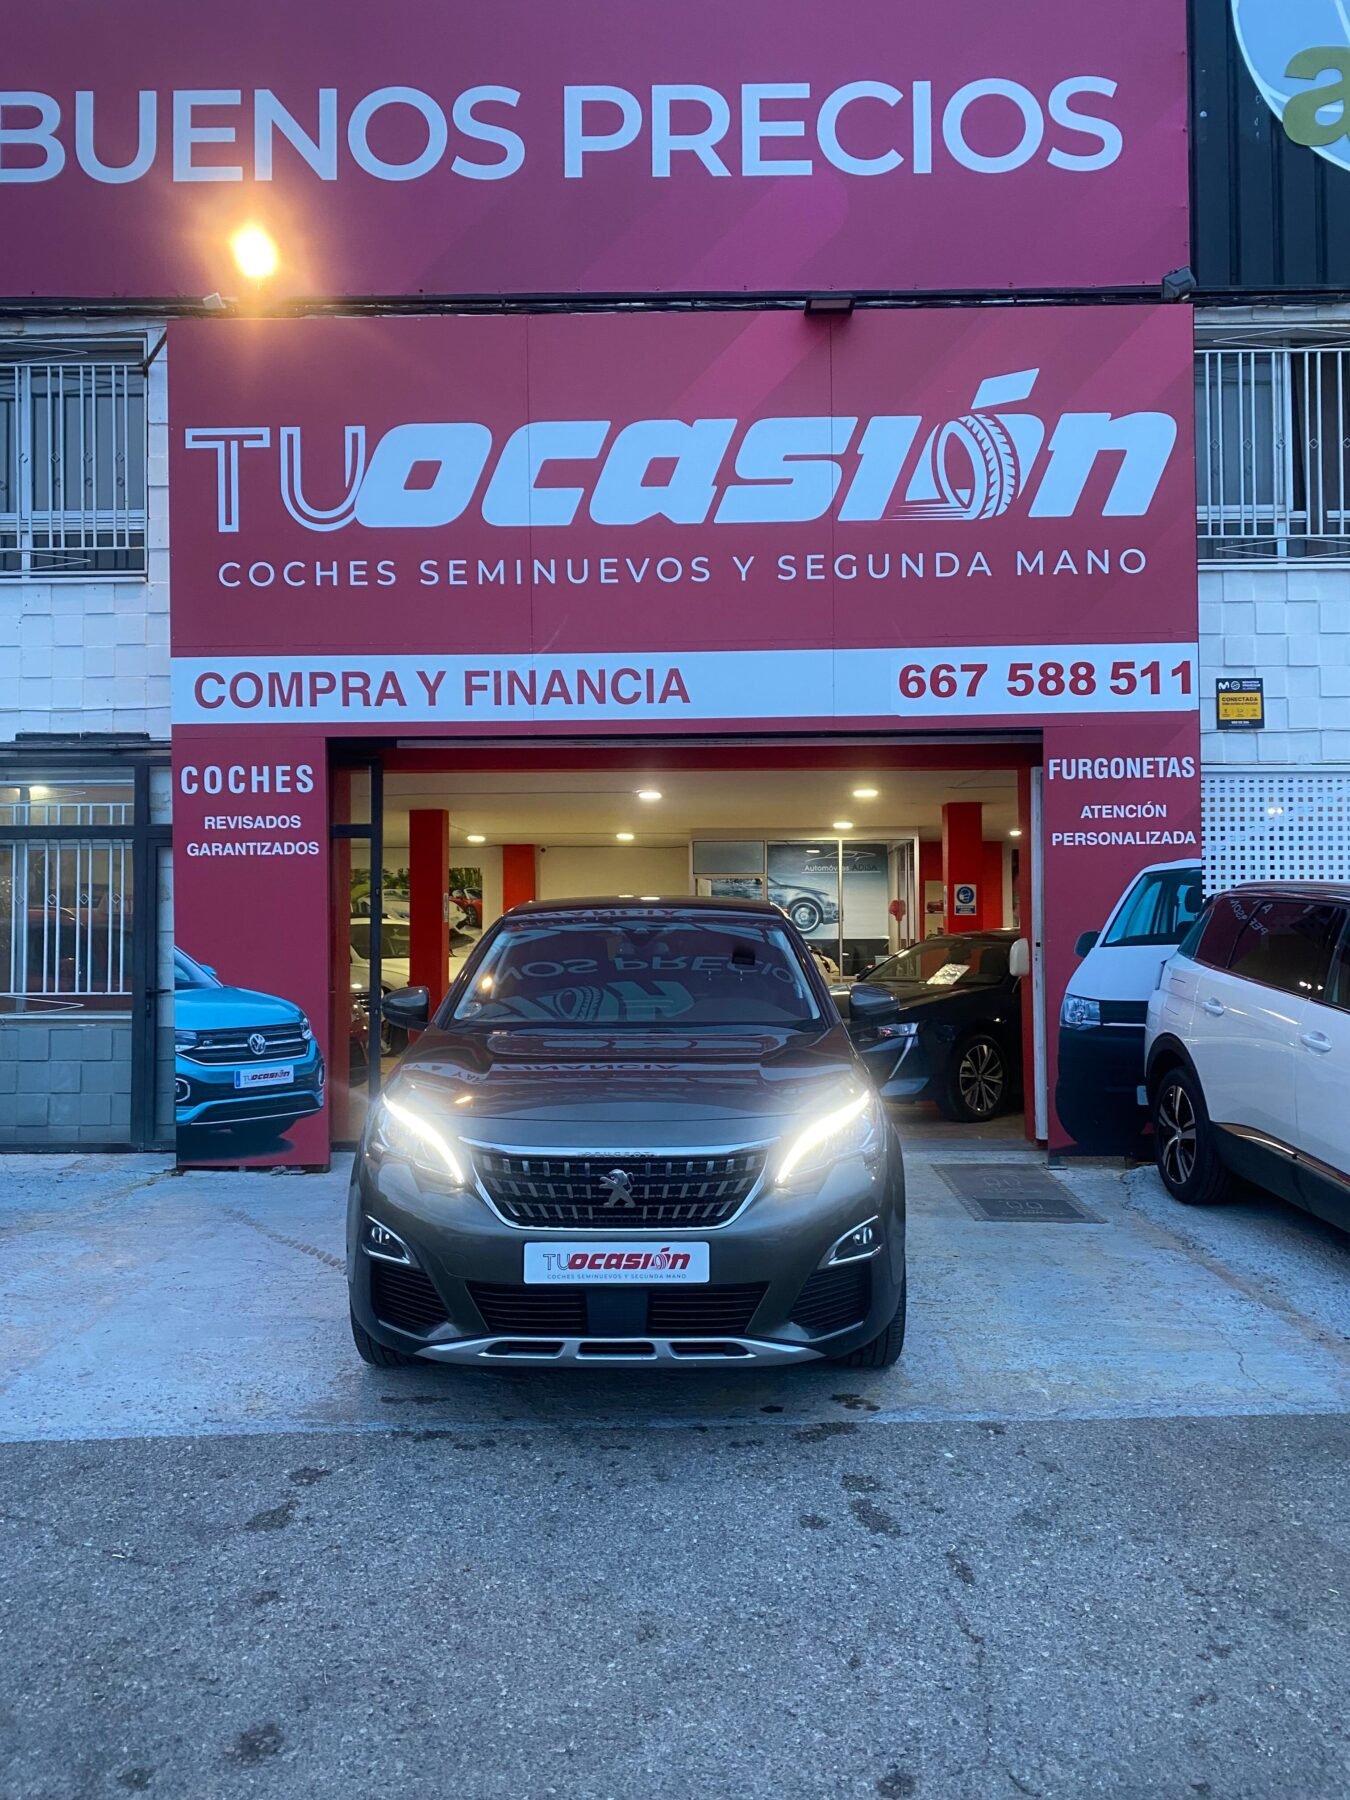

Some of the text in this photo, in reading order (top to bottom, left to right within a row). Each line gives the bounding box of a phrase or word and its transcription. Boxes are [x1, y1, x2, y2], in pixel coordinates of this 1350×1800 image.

[0, 76, 1123, 184] BUENOS PRECIOS
[218, 548, 1146, 588] COCHES SEMINUEVOS Y SEGUNDA MANO
[194, 667, 691, 710] COMPRA Y FINANCIA
[898, 660, 1192, 699] 667 588 511
[180, 764, 314, 795] COCHES
[1048, 756, 1196, 780] FURGONETAS
[203, 814, 302, 830] REVISADOS
[1080, 800, 1167, 820] ATENCIÓN
[186, 841, 320, 857] GARANTIZADOS
[1052, 830, 1197, 847] PERSONALIZADA
[666, 1272, 687, 1280] MANO
